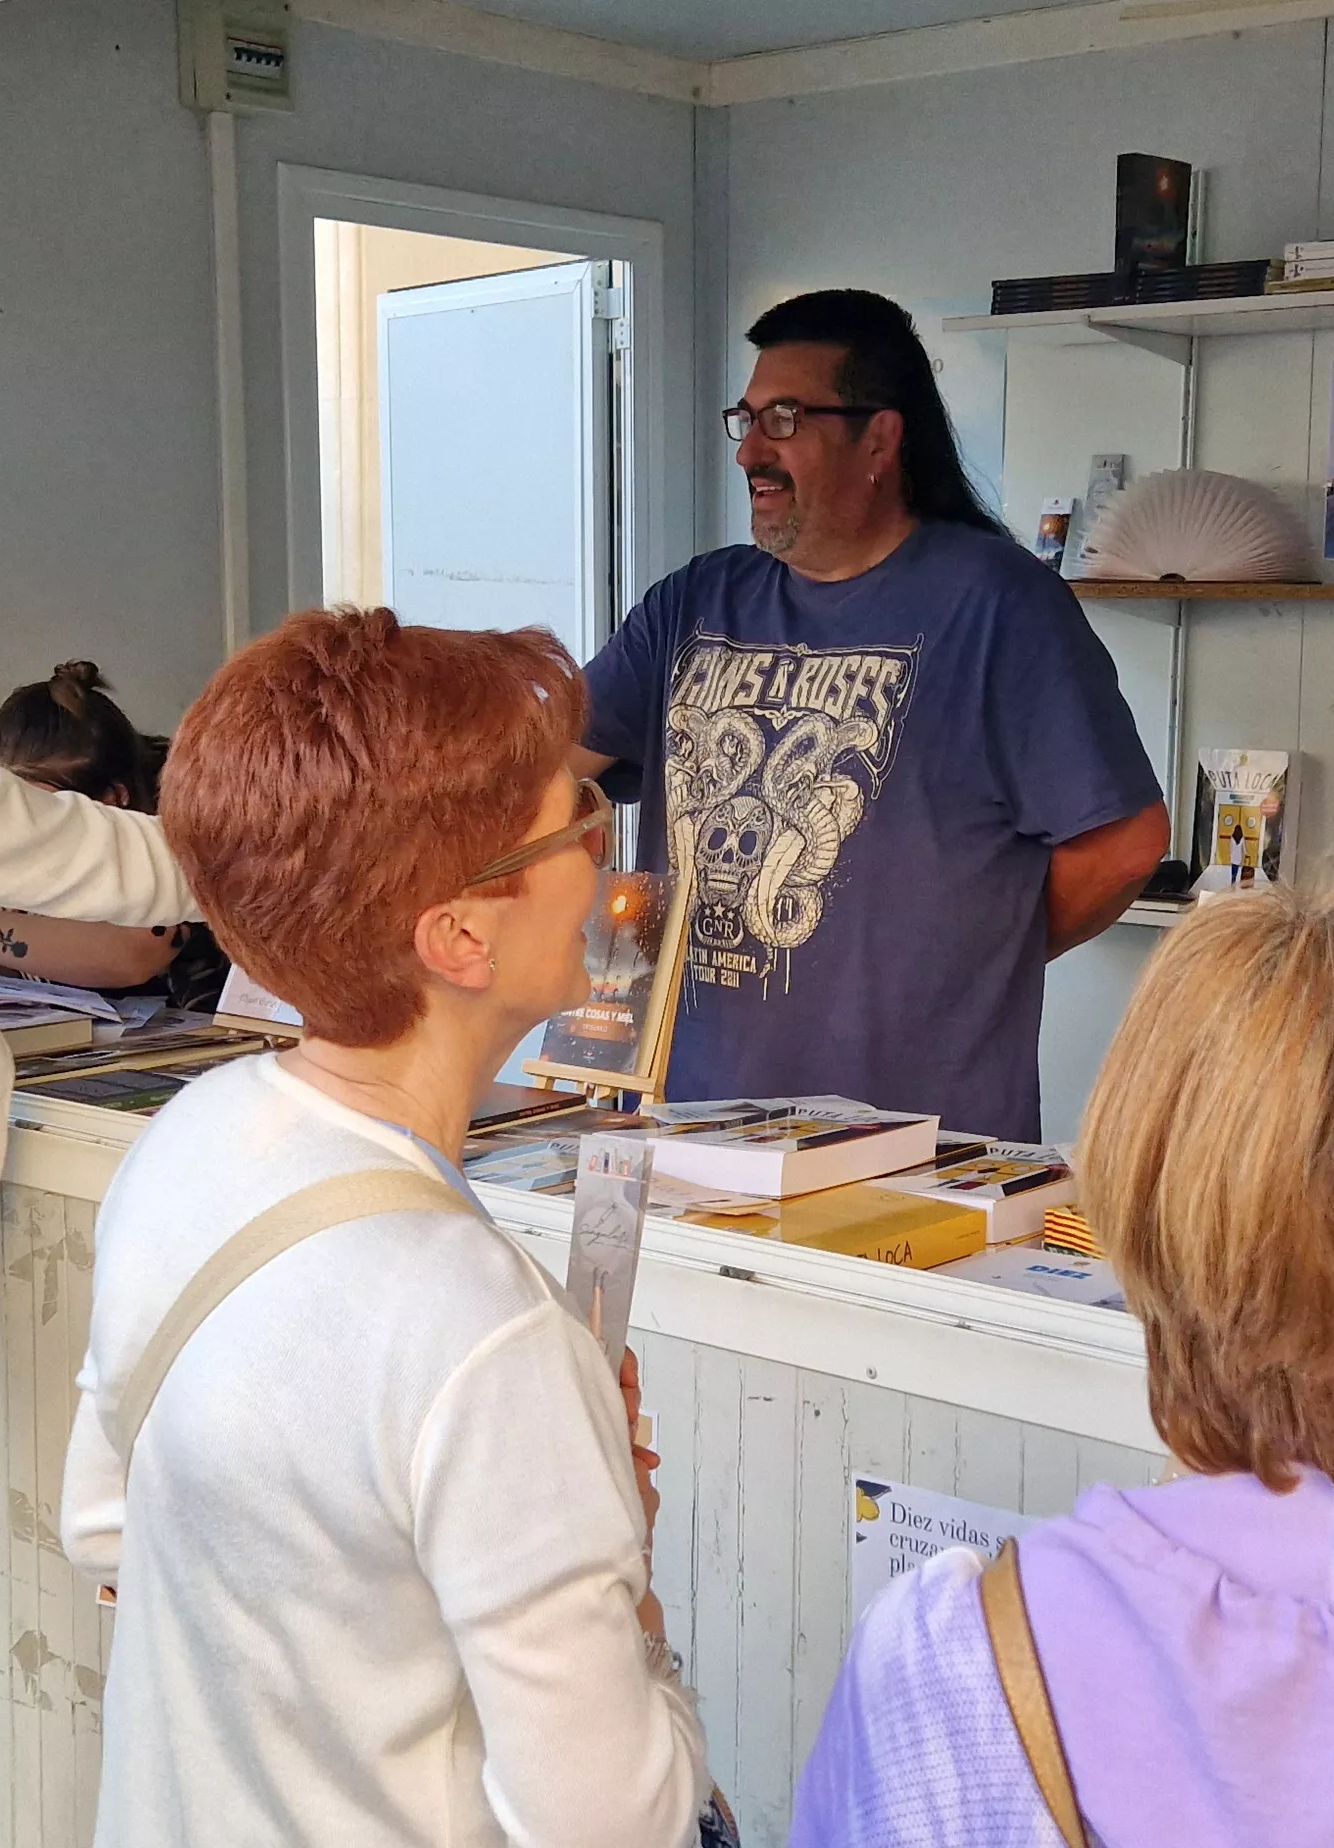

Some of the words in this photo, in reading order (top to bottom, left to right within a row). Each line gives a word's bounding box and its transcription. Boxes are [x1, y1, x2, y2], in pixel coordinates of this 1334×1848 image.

[1208, 770, 1241, 790] PUTA
[702, 917, 735, 940] GNR
[711, 949, 758, 974] AMERICA
[693, 964, 716, 985] TOUR
[720, 968, 741, 988] 2011
[585, 1008, 610, 1022] COSAS
[611, 1010, 618, 1022] Y
[876, 1240, 913, 1266] LOCA
[1026, 1265, 1093, 1280] DIEZ
[889, 1501, 933, 1533] Diez
[939, 1518, 990, 1549] vidas
